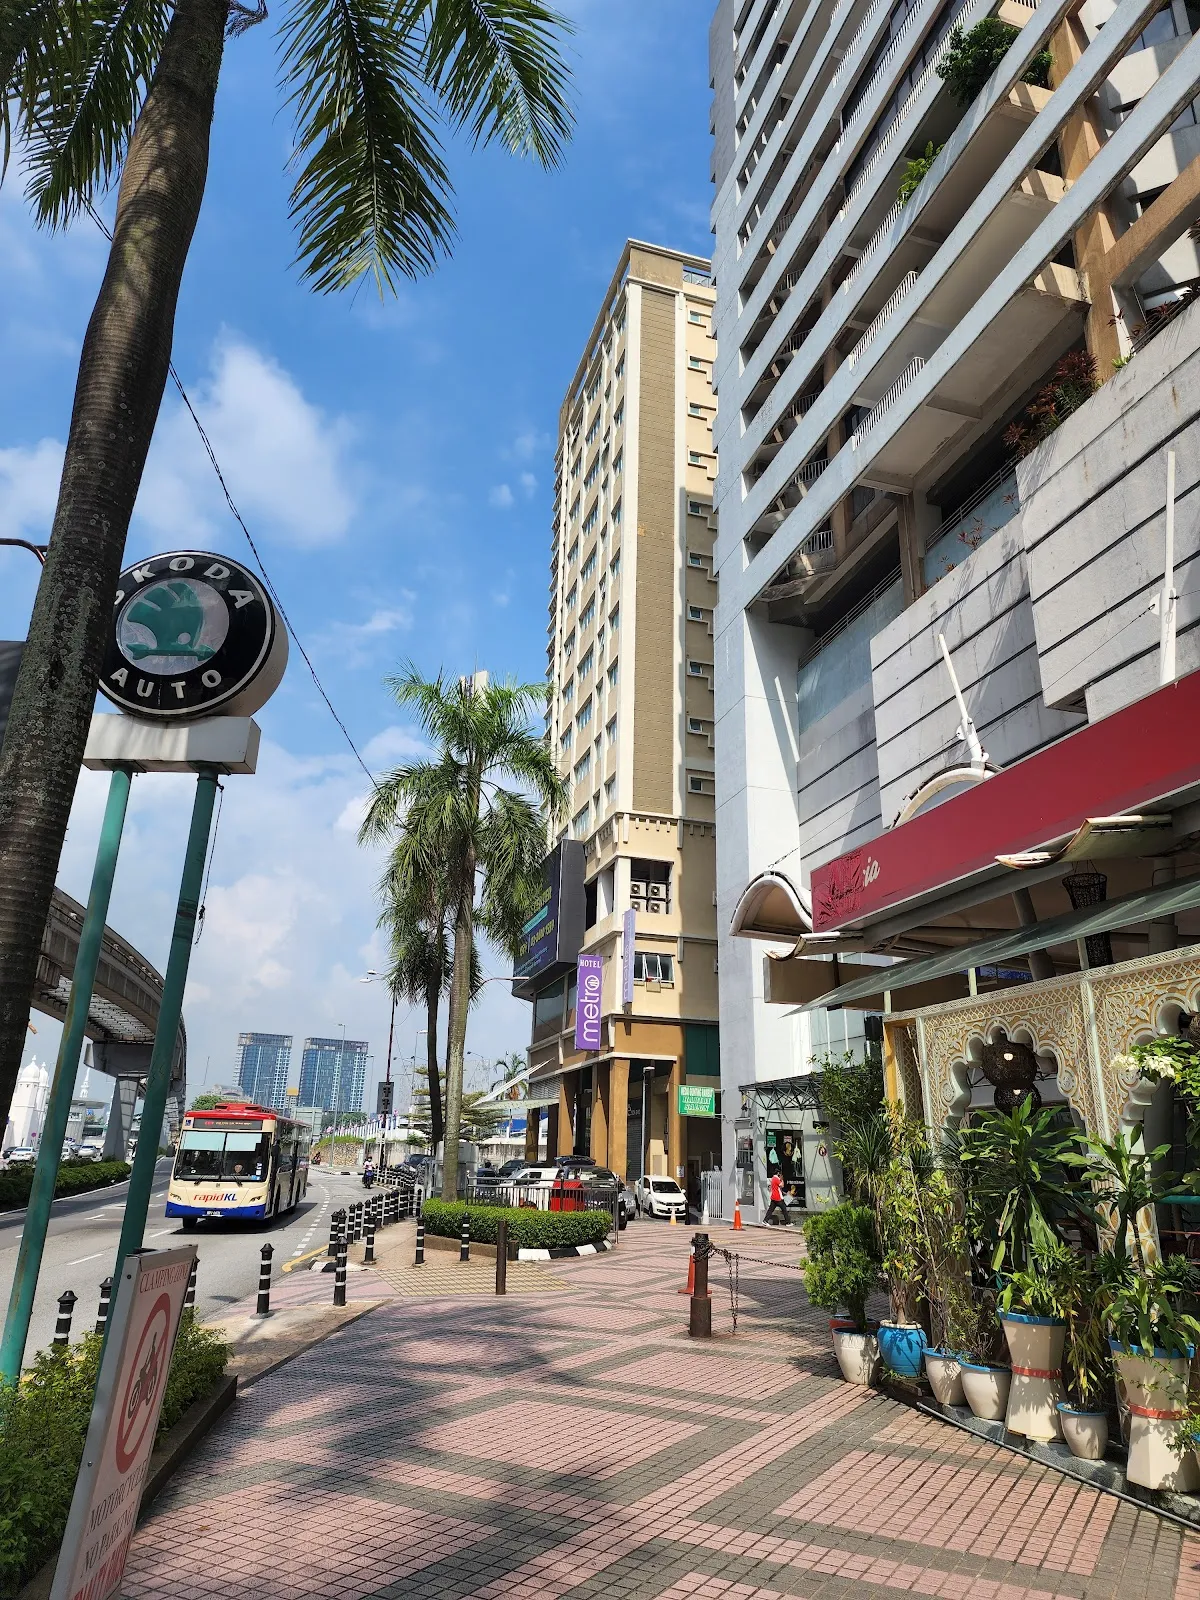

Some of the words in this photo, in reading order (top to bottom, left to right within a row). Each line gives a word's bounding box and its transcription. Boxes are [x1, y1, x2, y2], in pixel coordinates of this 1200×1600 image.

[110, 667, 222, 699] AUTO
[579, 959, 601, 969] HOTEL
[579, 974, 601, 1042] metro
[193, 1193, 238, 1203] rapidKL
[139, 1266, 176, 1294] CLAMPING
[79, 1540, 101, 1579] NO
[97, 1500, 136, 1560] PARKING
